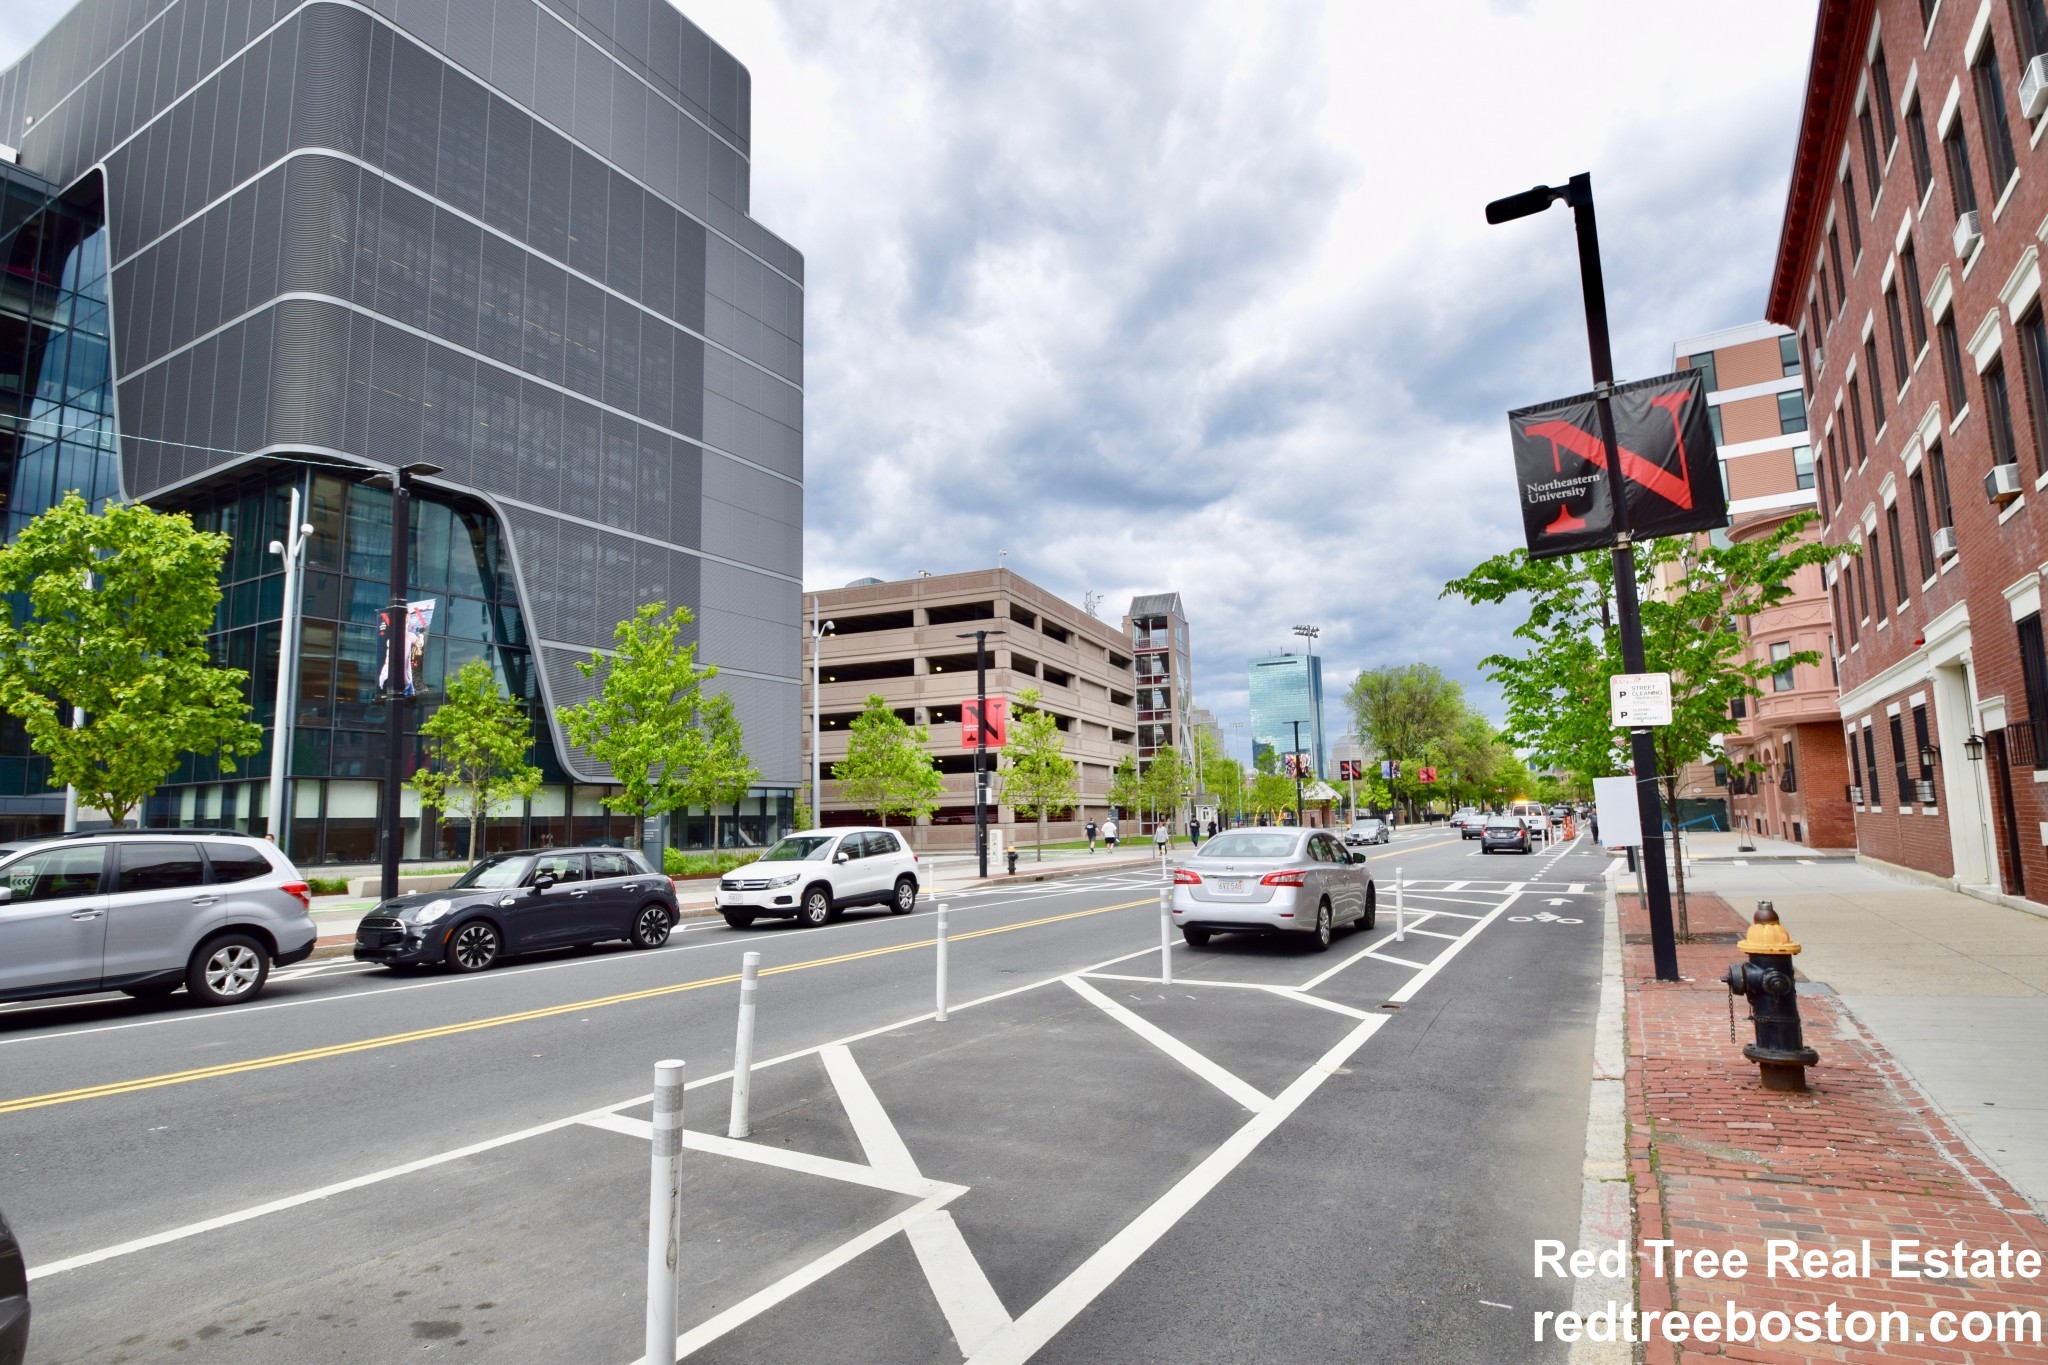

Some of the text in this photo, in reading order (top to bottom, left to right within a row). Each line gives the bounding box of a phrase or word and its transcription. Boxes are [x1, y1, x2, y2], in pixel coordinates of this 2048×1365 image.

[1526, 473, 1600, 494] Northeastern
[1527, 486, 1587, 504] University
[1619, 691, 1627, 699] P
[1620, 711, 1628, 719] P
